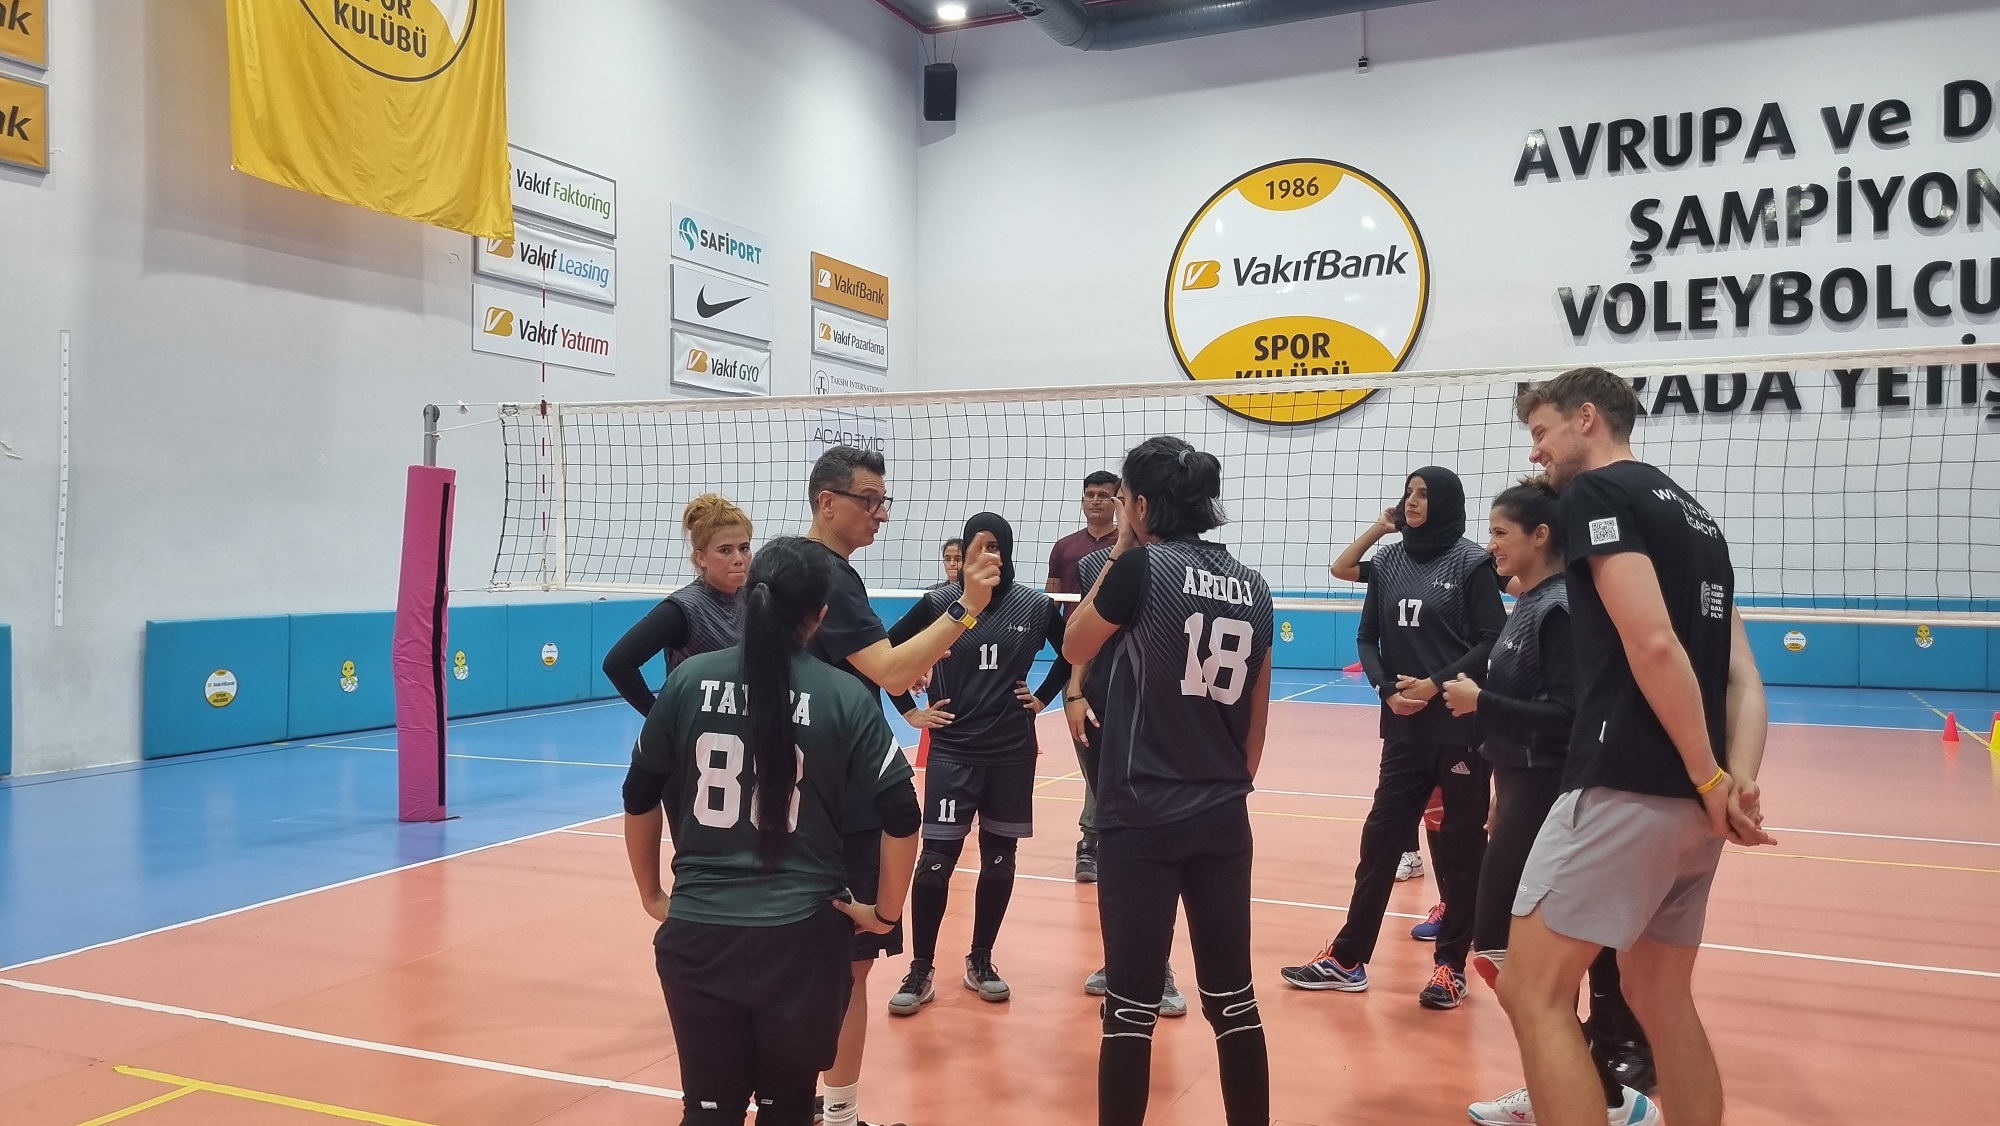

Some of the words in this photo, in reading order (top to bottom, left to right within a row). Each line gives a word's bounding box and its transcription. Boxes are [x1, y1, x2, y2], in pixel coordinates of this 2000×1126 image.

[334, 0, 427, 58] KULÜBÜ
[1513, 101, 1797, 184] AVRUPA
[1820, 98, 1912, 151] ve
[516, 168, 551, 197] Vakıf
[552, 181, 611, 220] Faktoring
[1265, 176, 1320, 200] 1986
[520, 242, 558, 270] Vakıf
[558, 253, 610, 288] Leasing
[1233, 245, 1409, 287] VakıfBank
[834, 273, 885, 306] VakıfBank
[519, 318, 559, 346] Vakıf
[560, 327, 609, 356] Yatırım
[833, 329, 851, 347] Vakıf
[851, 335, 885, 356] Pazarlama
[1254, 332, 1331, 361] SPOR
[711, 357, 738, 379] Vakıf
[738, 363, 760, 383] GYO
[1397, 598, 1423, 627] 17
[978, 643, 999, 670] 11
[1180, 611, 1254, 706] 18
[937, 798, 956, 823] 11
